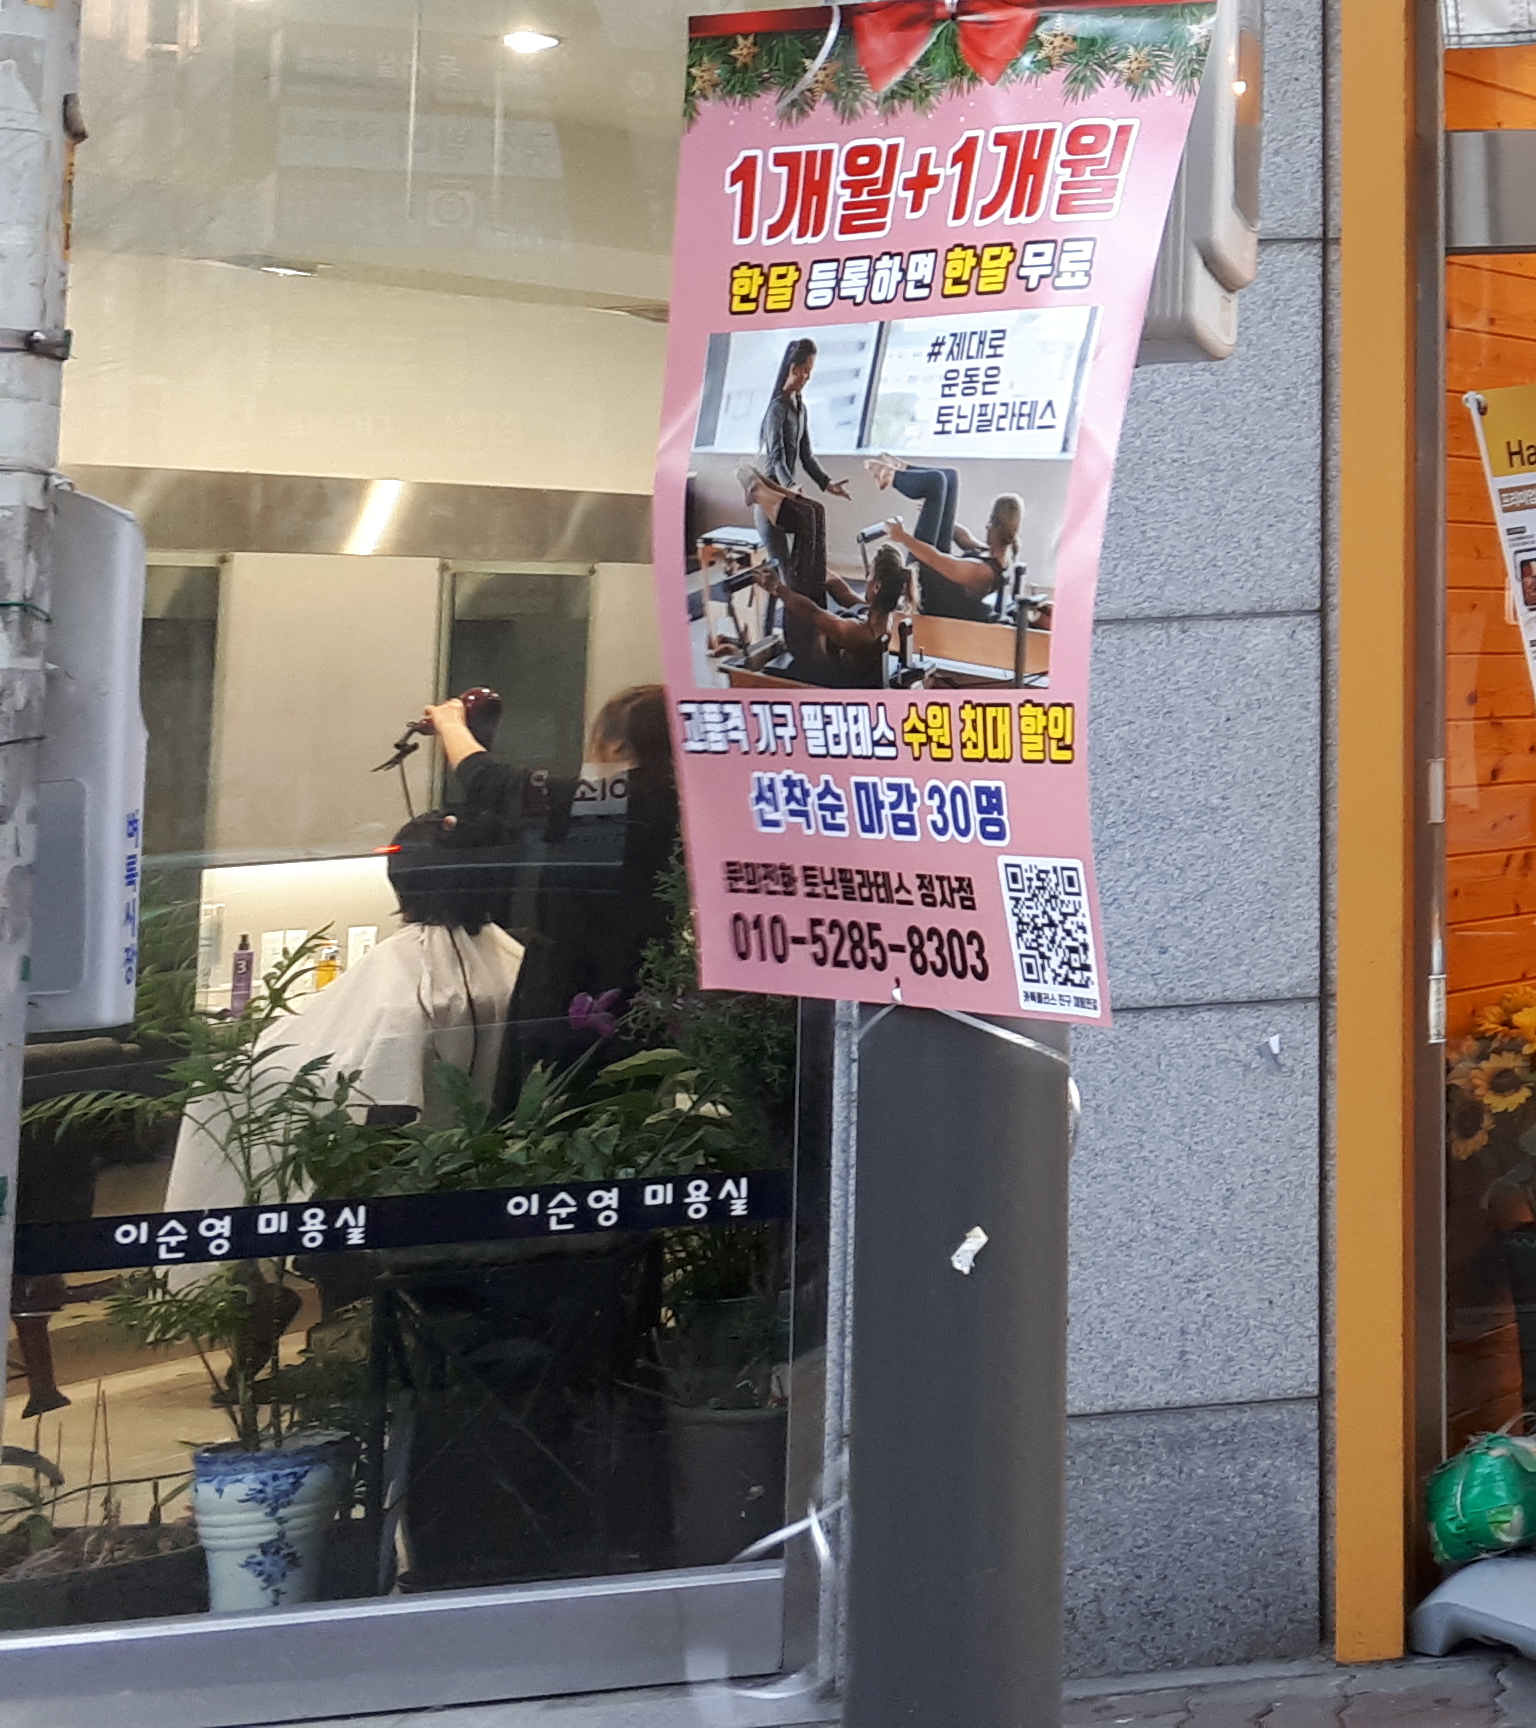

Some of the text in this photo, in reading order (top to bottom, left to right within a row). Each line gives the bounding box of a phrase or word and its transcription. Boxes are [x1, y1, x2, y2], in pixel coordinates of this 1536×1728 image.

[730, 237, 1098, 315] 한달 등록하면 한달 무료
[939, 366, 1002, 399] 운동은
[933, 402, 1058, 437] 토닌필라테스
[800, 702, 898, 761] 필라테스
[902, 703, 952, 761] 수원
[959, 703, 1013, 762] 최대
[1018, 702, 1075, 764] 할인
[749, 771, 1011, 847] 선착순 마감 30명
[916, 873, 977, 911] 정자점
[730, 911, 990, 983] 010-5285-8303
[114, 1204, 367, 1260] 이순영 미용실
[506, 1176, 750, 1232] 이순영 미용실
